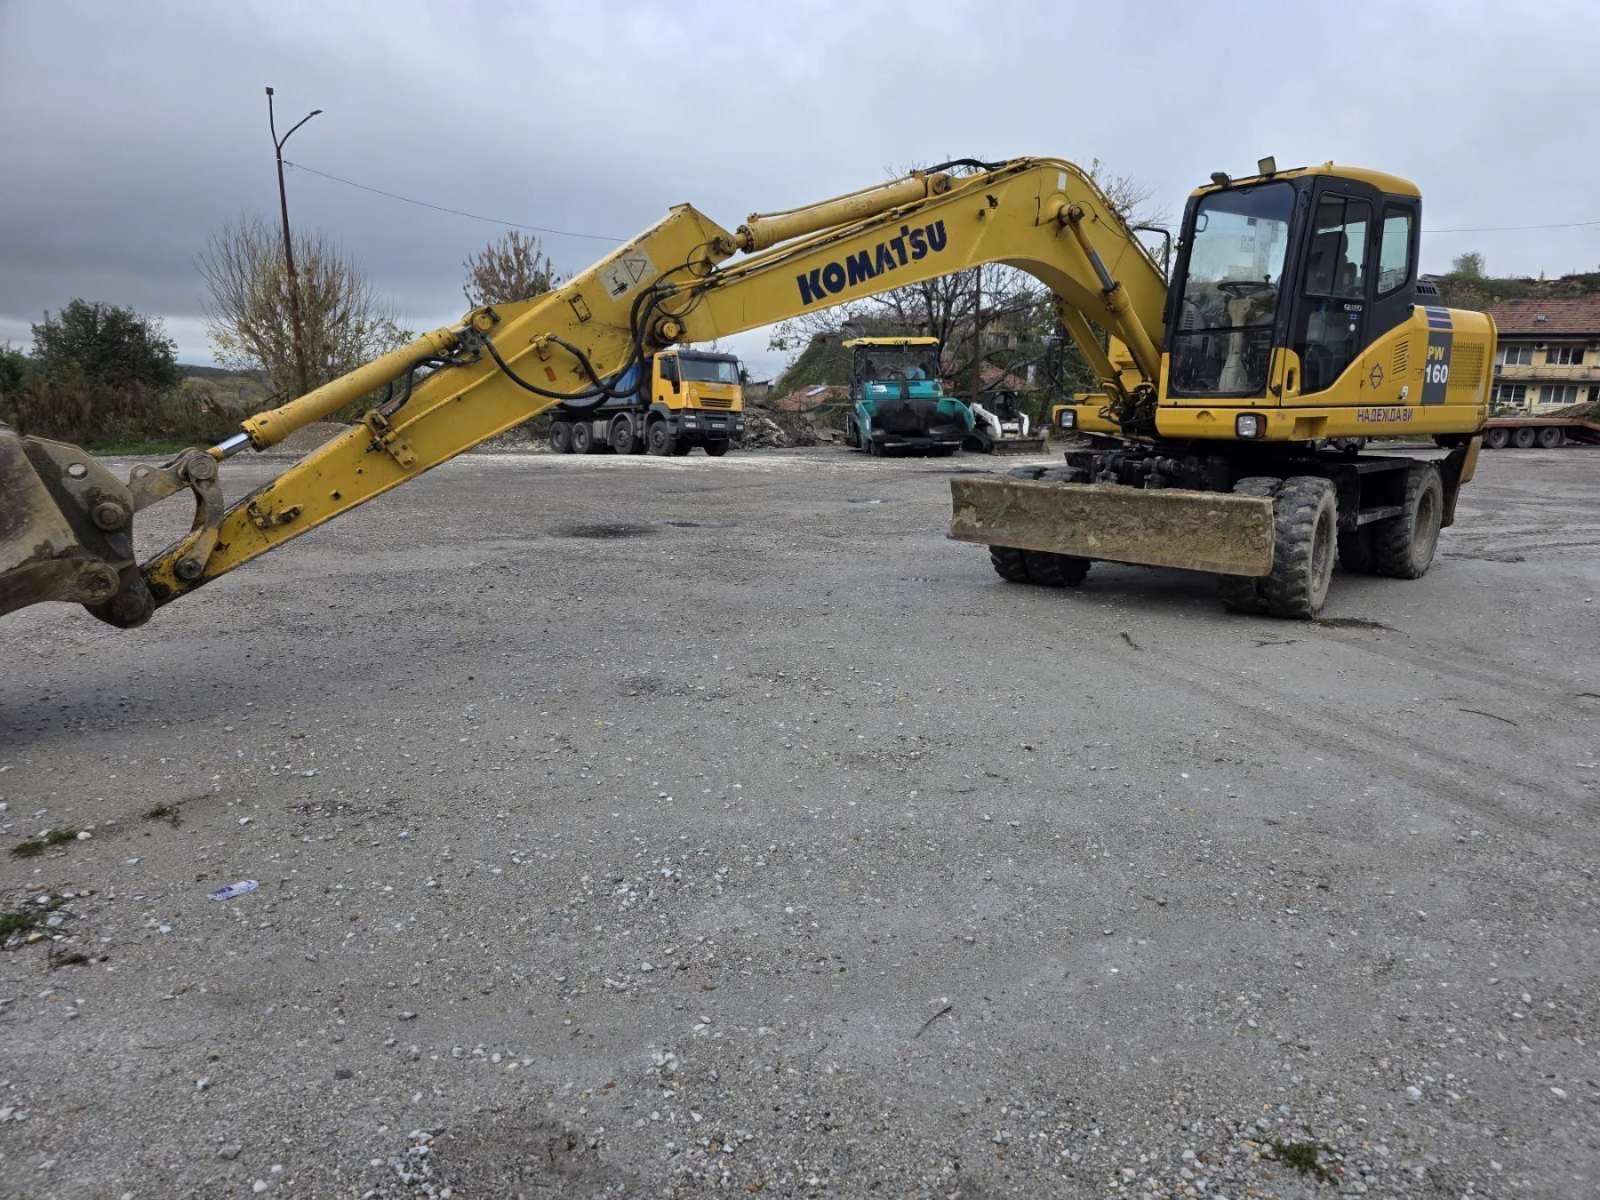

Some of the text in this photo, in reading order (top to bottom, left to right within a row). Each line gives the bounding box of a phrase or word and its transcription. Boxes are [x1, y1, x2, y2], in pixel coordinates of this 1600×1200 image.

[796, 219, 948, 306] KOMATSU
[1427, 345, 1445, 361] PW
[1426, 363, 1449, 384] 160
